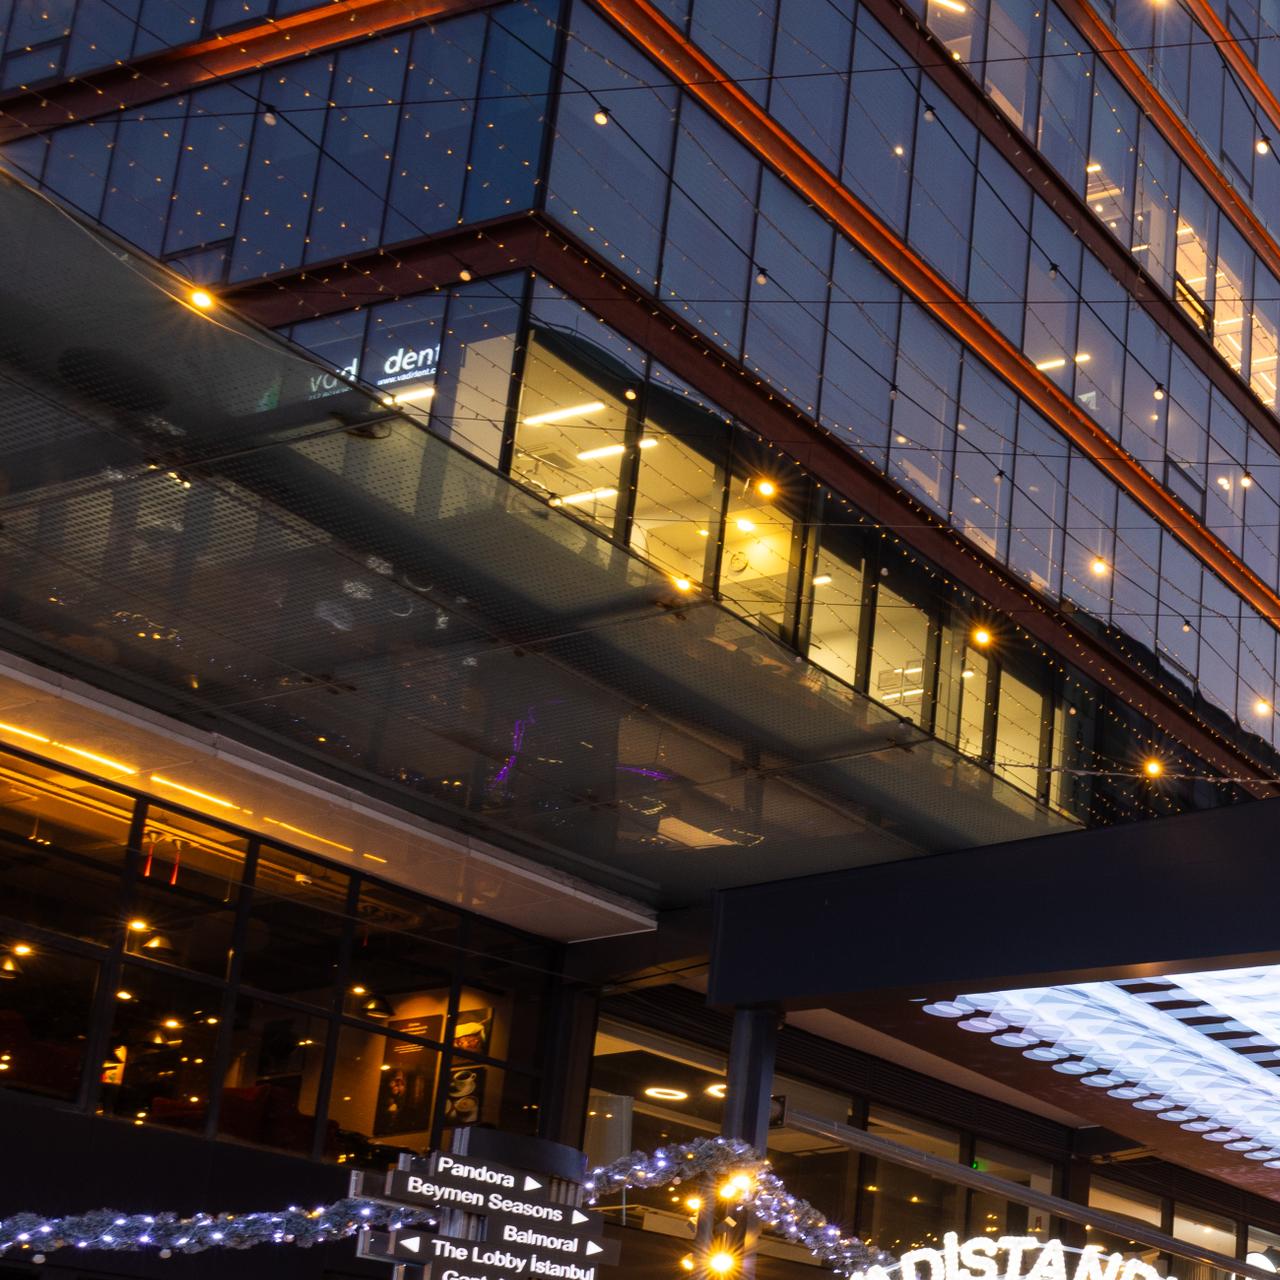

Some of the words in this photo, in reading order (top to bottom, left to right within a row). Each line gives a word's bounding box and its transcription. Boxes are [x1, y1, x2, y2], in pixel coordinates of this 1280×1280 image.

[437, 1156, 515, 1188] Pandora
[407, 1176, 484, 1207] Beymen
[488, 1194, 563, 1222] Seasons
[503, 1225, 578, 1253] Balmoral
[432, 1239, 468, 1260] The
[472, 1247, 527, 1274] Lobby
